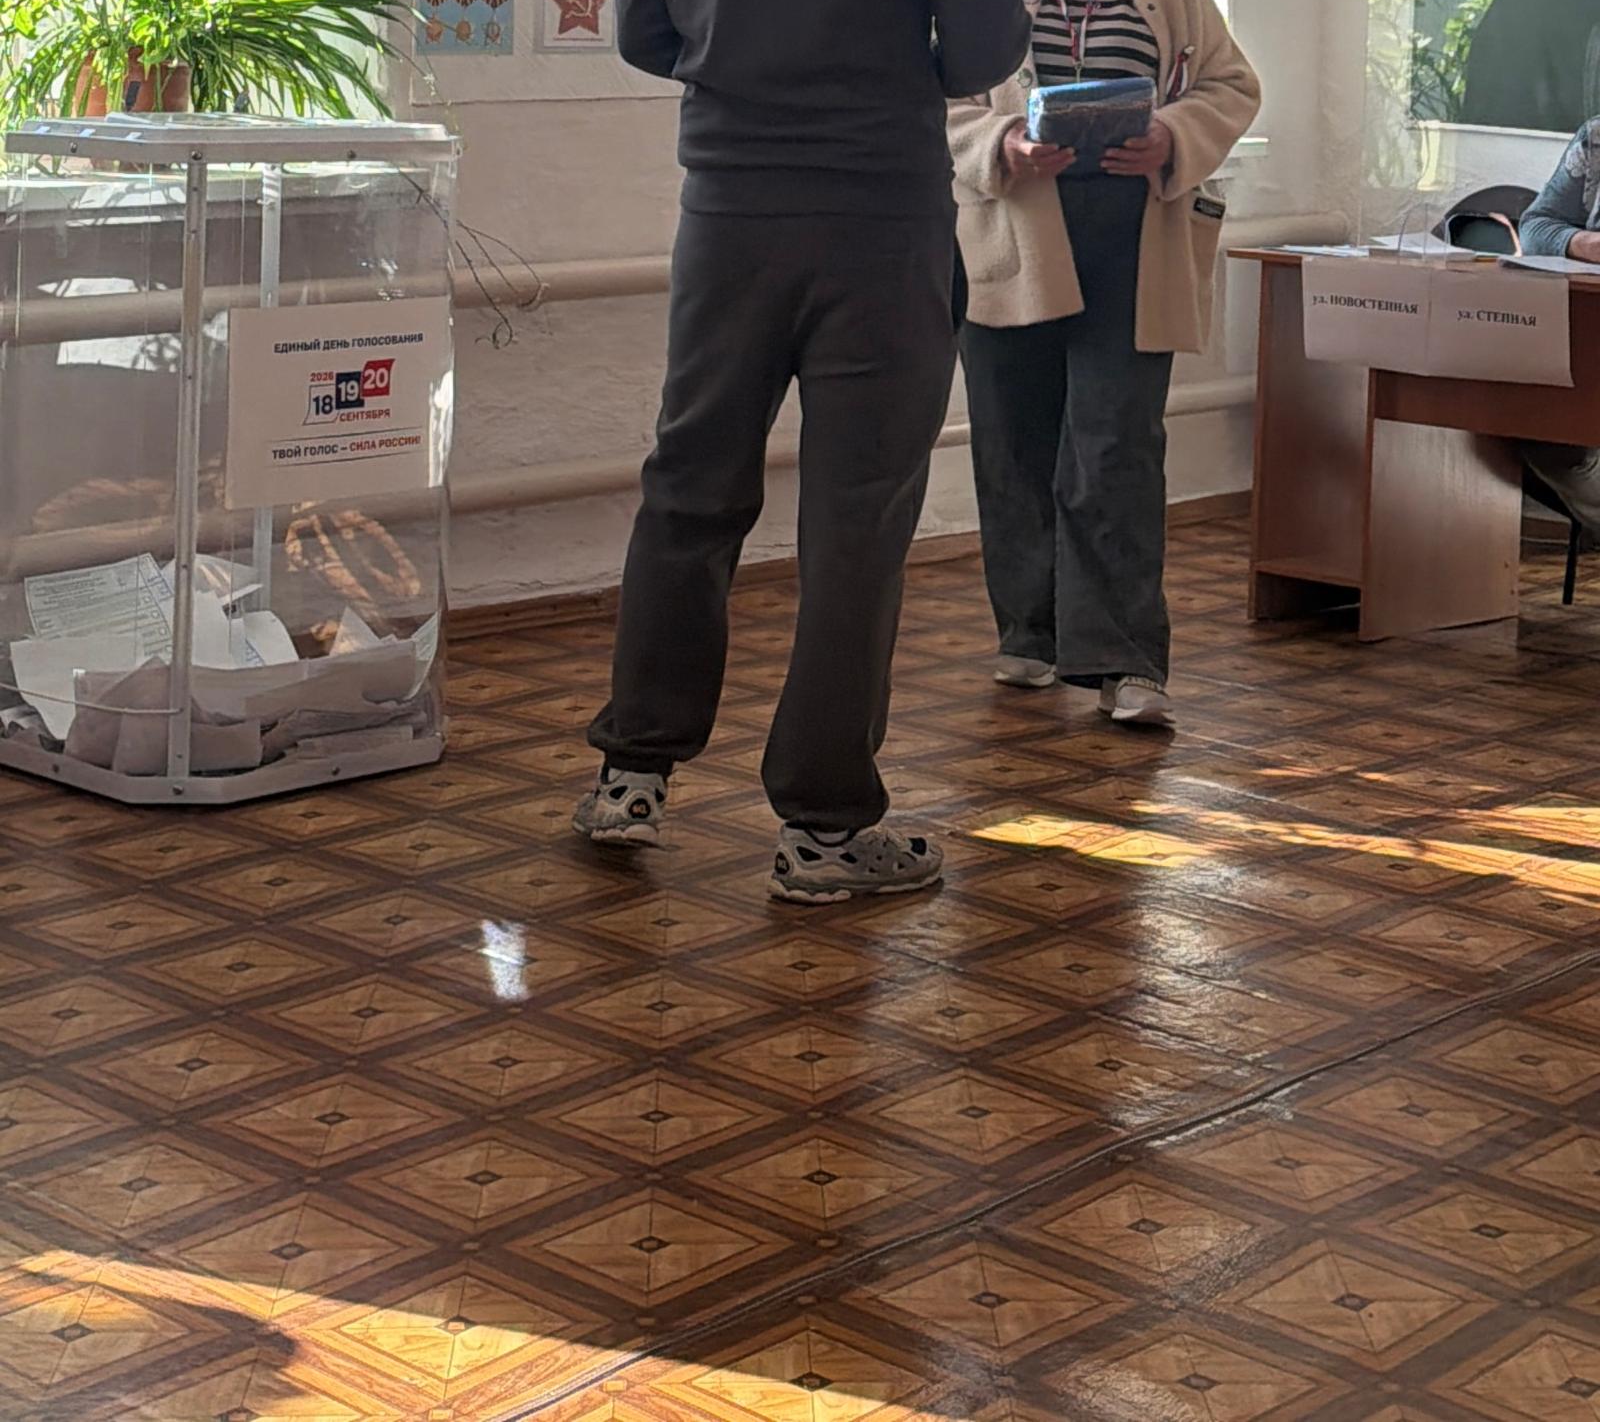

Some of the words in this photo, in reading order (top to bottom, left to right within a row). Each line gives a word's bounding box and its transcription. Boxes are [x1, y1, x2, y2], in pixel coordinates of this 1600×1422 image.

[1313, 295, 1327, 305] ул.
[1457, 309, 1473, 321] ул.
[1476, 309, 1537, 327] СТЕПНАЯ
[274, 339, 320, 354] ЕДИНЫЙ
[323, 337, 349, 351] ДЕНЬ
[352, 332, 423, 348] ГОЛОСОВАНИЯ
[310, 371, 334, 382] 2026
[312, 395, 333, 416] 18
[338, 380, 359, 402] 19
[363, 368, 388, 389] 20
[339, 408, 390, 422] СЕНТЯБРЯ
[272, 443, 301, 460] ТВОЙ
[304, 444, 338, 456] ГОЛОС
[350, 439, 376, 452] СИЛА
